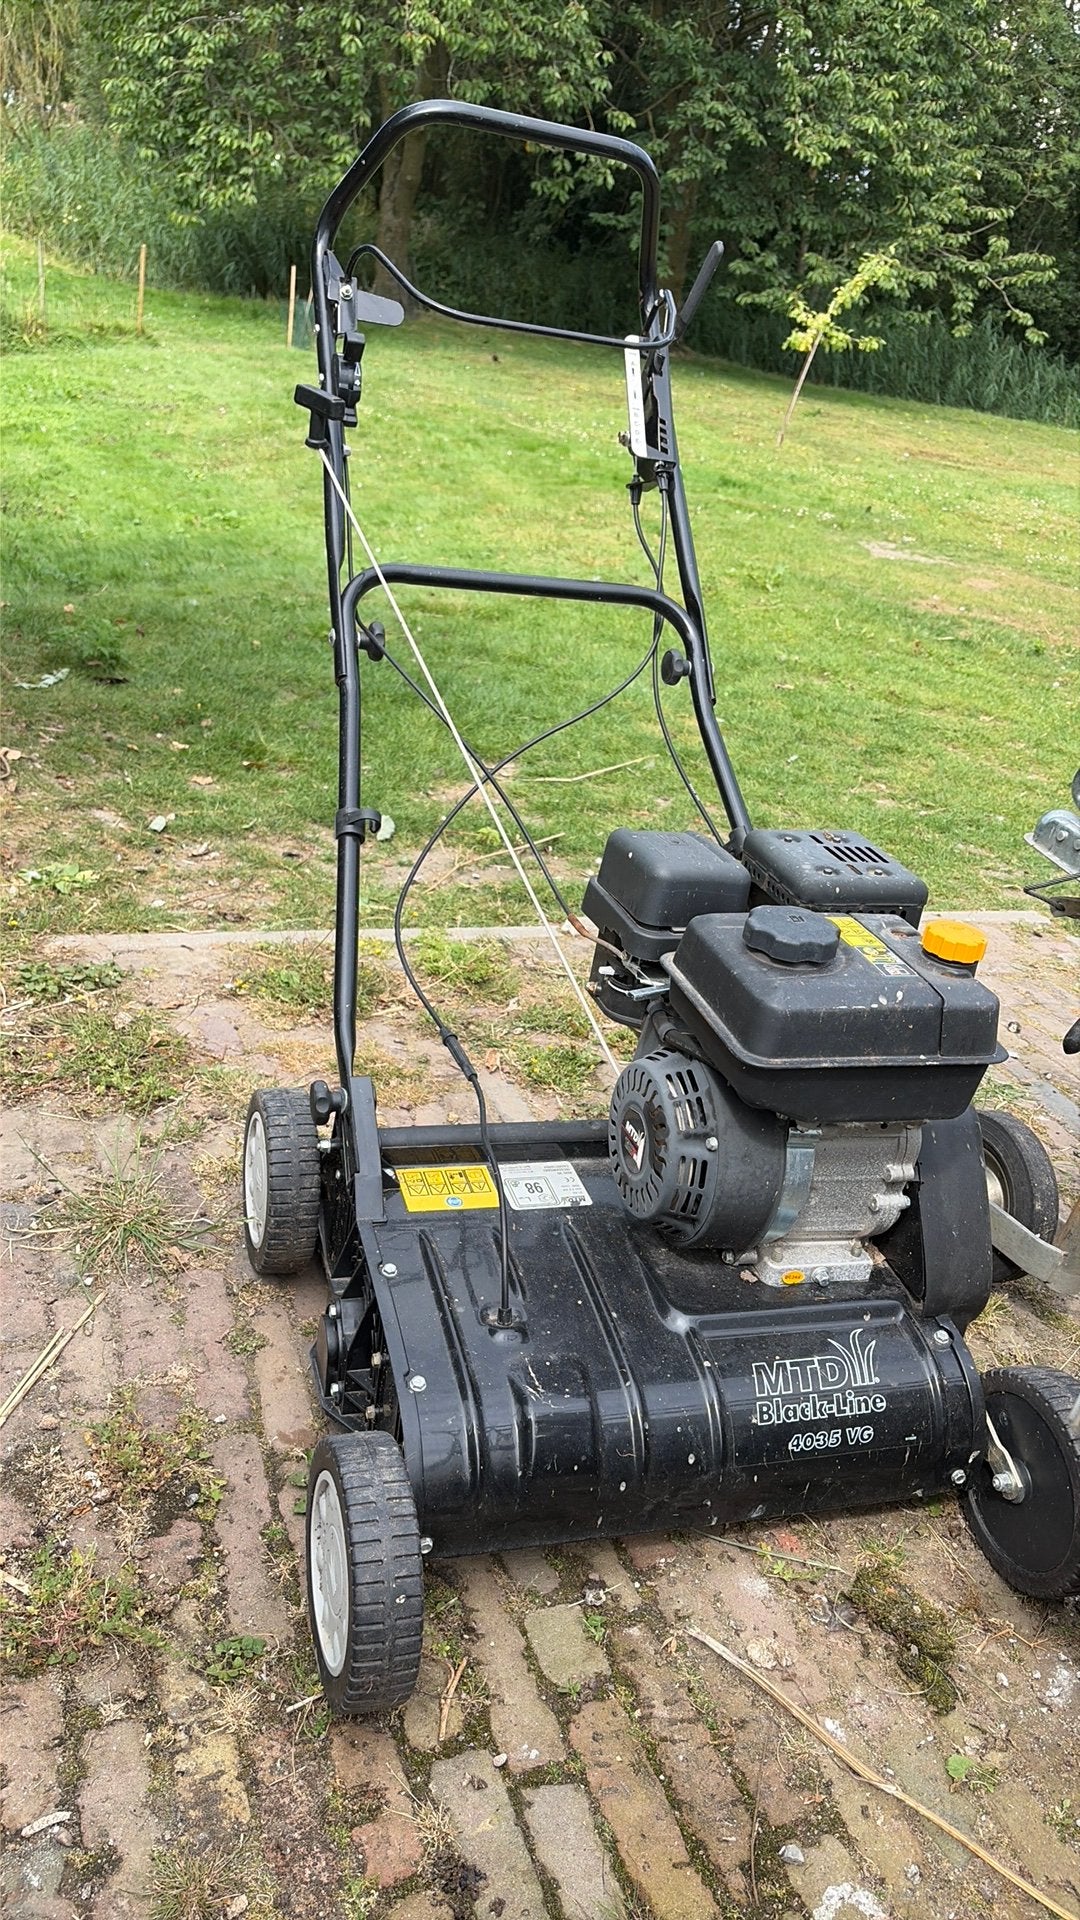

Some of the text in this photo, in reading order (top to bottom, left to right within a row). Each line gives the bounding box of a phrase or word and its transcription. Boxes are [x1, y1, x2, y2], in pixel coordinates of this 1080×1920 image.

[524, 1181, 544, 1194] 98
[752, 1355, 849, 1397] MTD
[756, 1390, 887, 1426] Black-Line
[789, 1426, 874, 1452] 4035 VG
